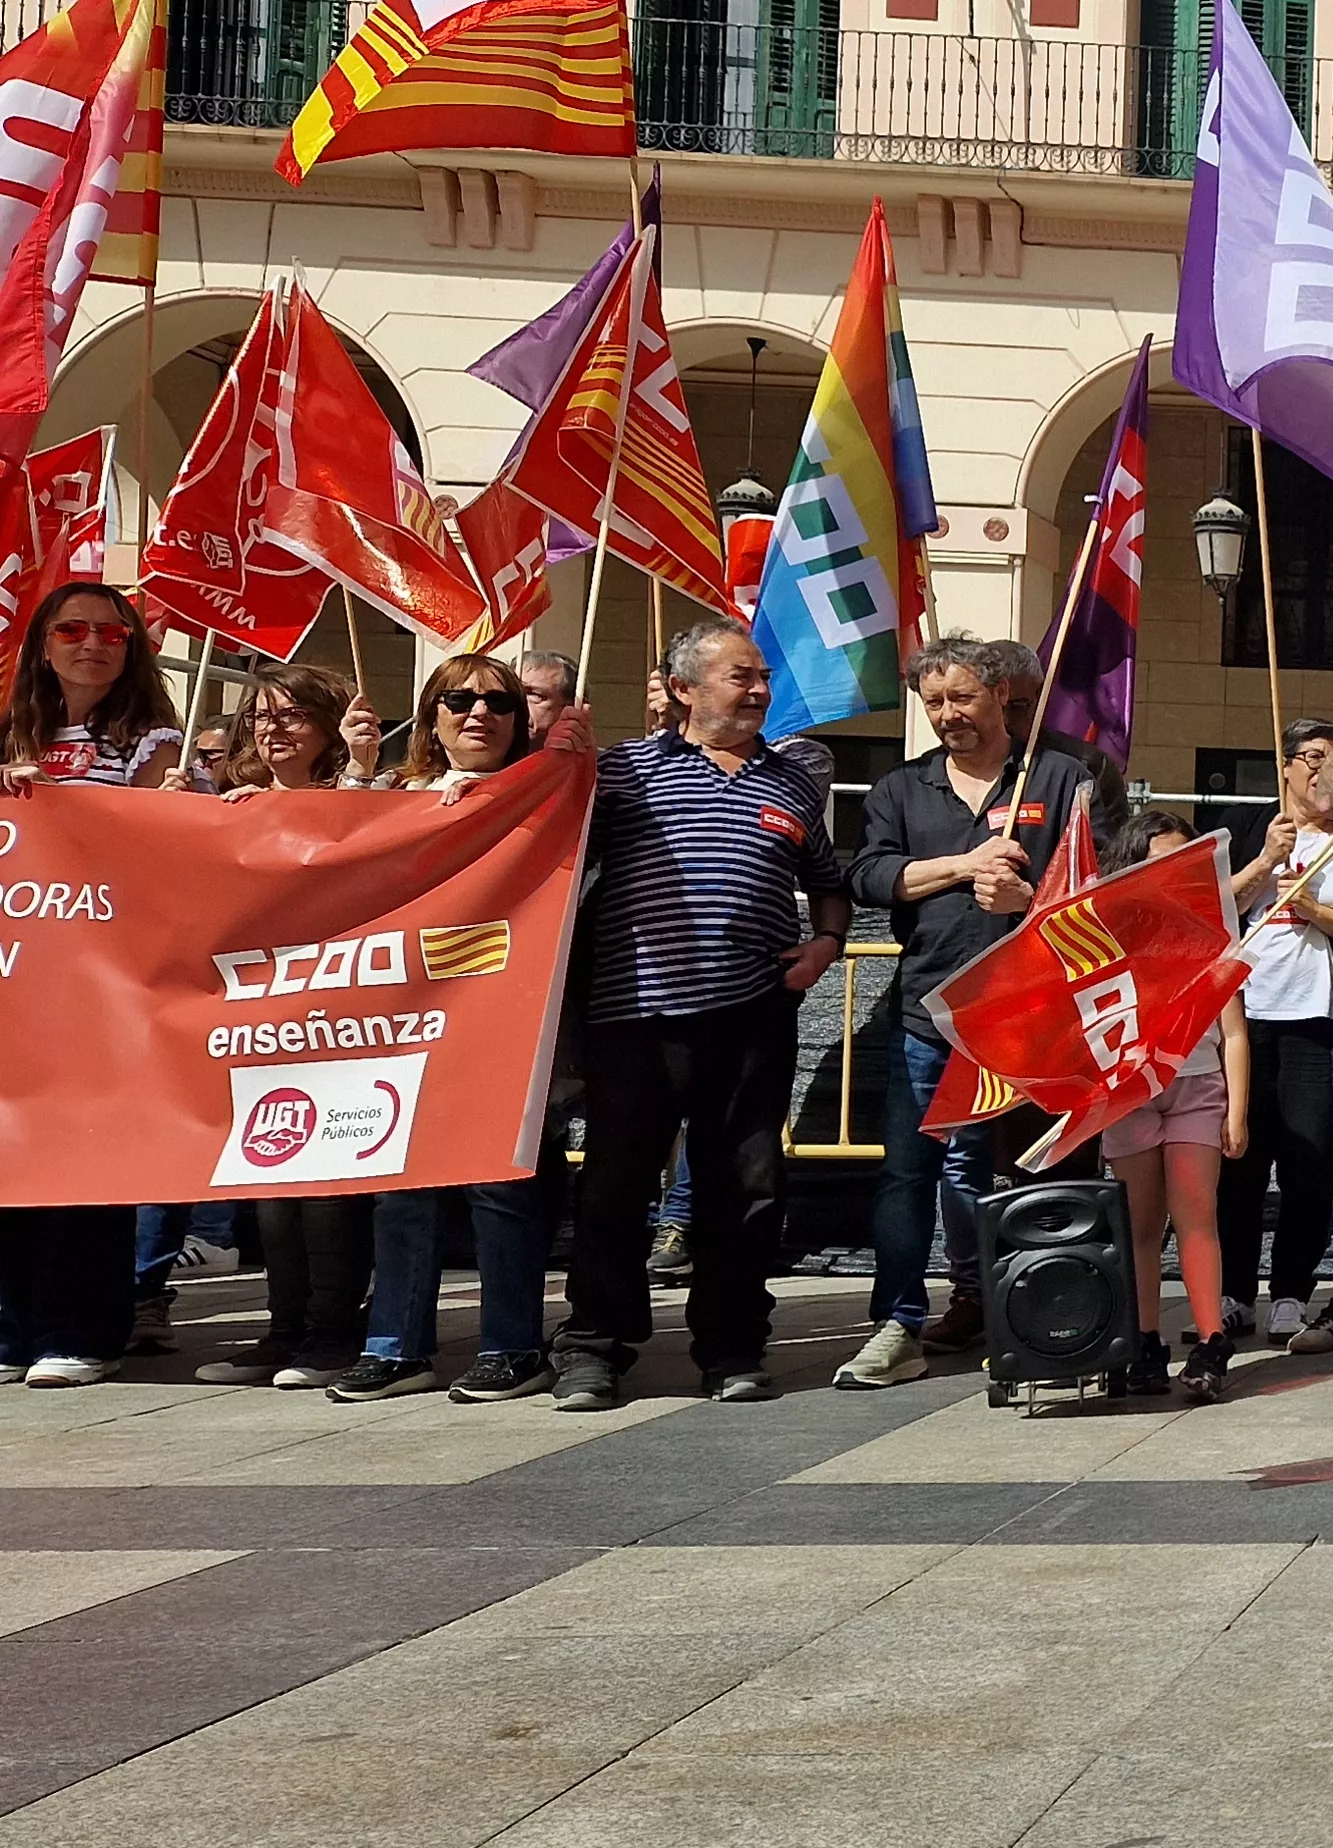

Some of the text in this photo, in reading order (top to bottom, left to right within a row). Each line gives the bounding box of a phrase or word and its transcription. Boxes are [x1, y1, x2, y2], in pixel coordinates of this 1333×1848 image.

[0, 881, 113, 921] ORAS
[212, 931, 408, 1001] CCOO
[207, 1008, 447, 1059] enseñanza
[252, 1100, 311, 1132] UGT
[326, 1106, 383, 1123] Servicios
[321, 1125, 374, 1141] Públicos
